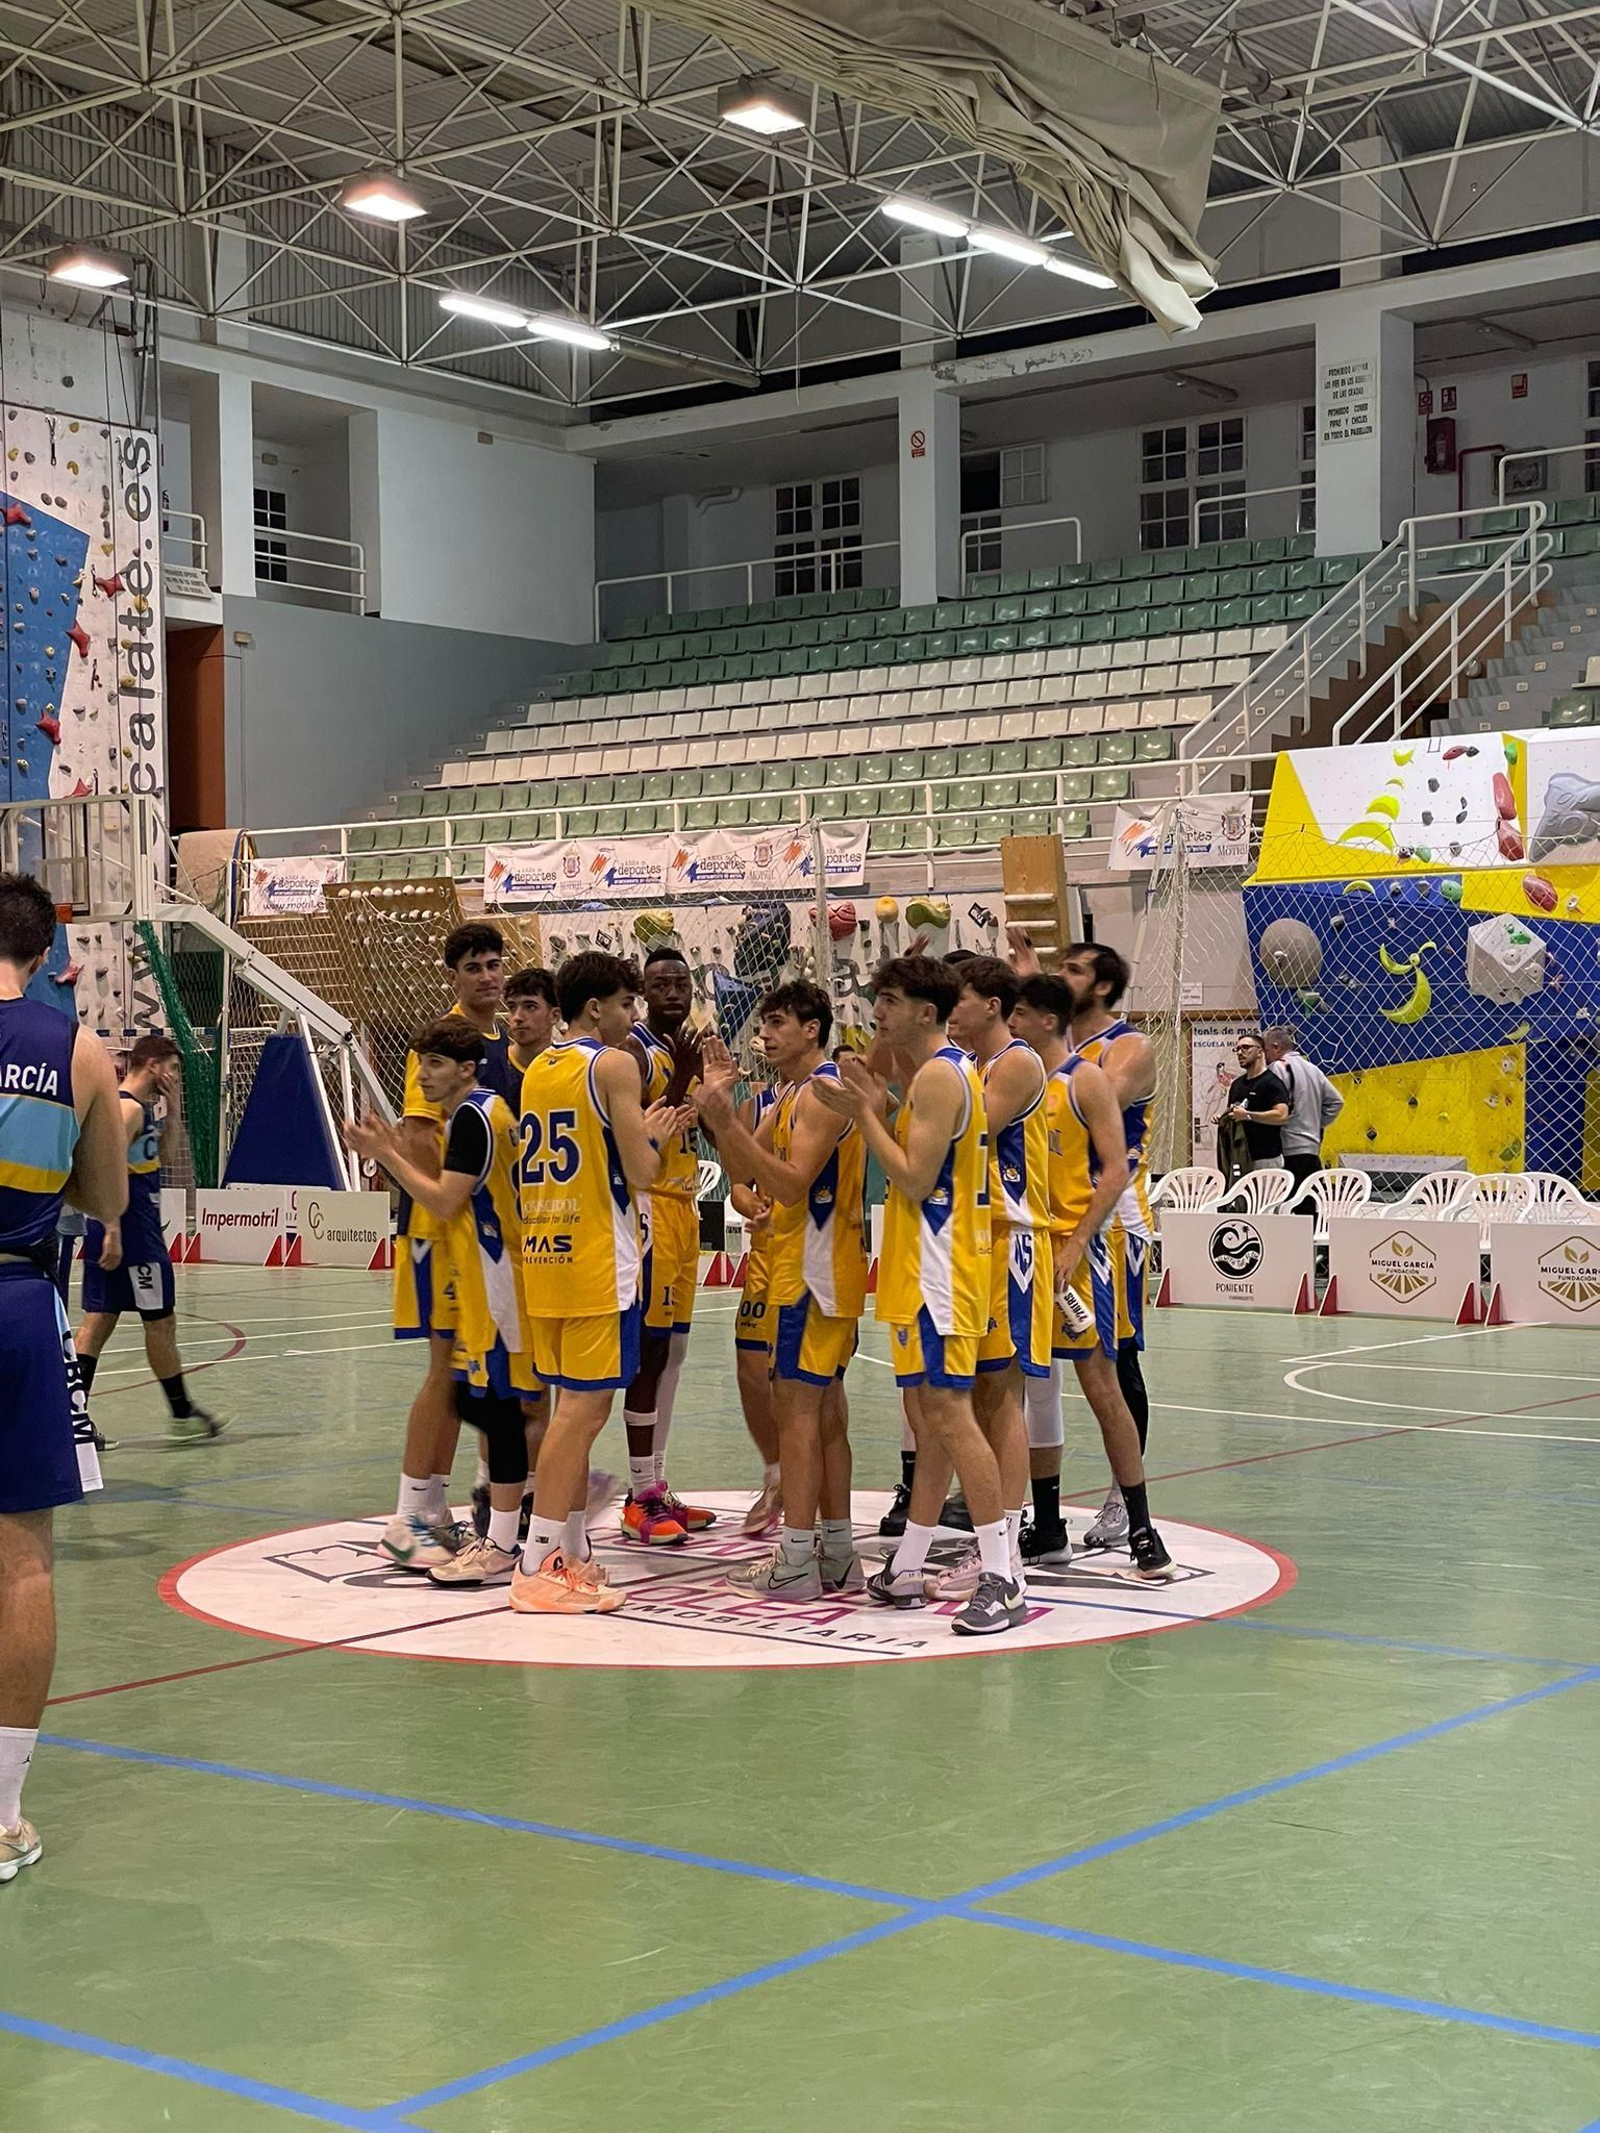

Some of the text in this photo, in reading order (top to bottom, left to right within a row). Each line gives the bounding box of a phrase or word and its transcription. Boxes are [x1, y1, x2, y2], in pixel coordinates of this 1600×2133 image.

[700, 858, 746, 873] deportes
[826, 853, 862, 866] portes
[618, 862, 662, 876] deportes
[277, 876, 320, 888] deportes
[514, 870, 557, 884] deportes
[263, 901, 325, 911] www.motril.e
[1194, 1026, 1260, 1036] tenis de mes
[0, 1063, 58, 1096] RCÍA
[520, 1110, 581, 1184] 25
[202, 1208, 279, 1232] Impermotril
[327, 1228, 378, 1243] arquitectos
[523, 1235, 572, 1253] MAS
[523, 1255, 573, 1264] REVENCIÓN
[1372, 1260, 1434, 1269] MIGUEL GARCÍA
[1541, 1266, 1600, 1275] MIGUEL GAR
[1216, 1282, 1254, 1294] PONIENTE
[741, 1300, 766, 1318] 00
[617, 1602, 929, 1648] MOBILIARIA
